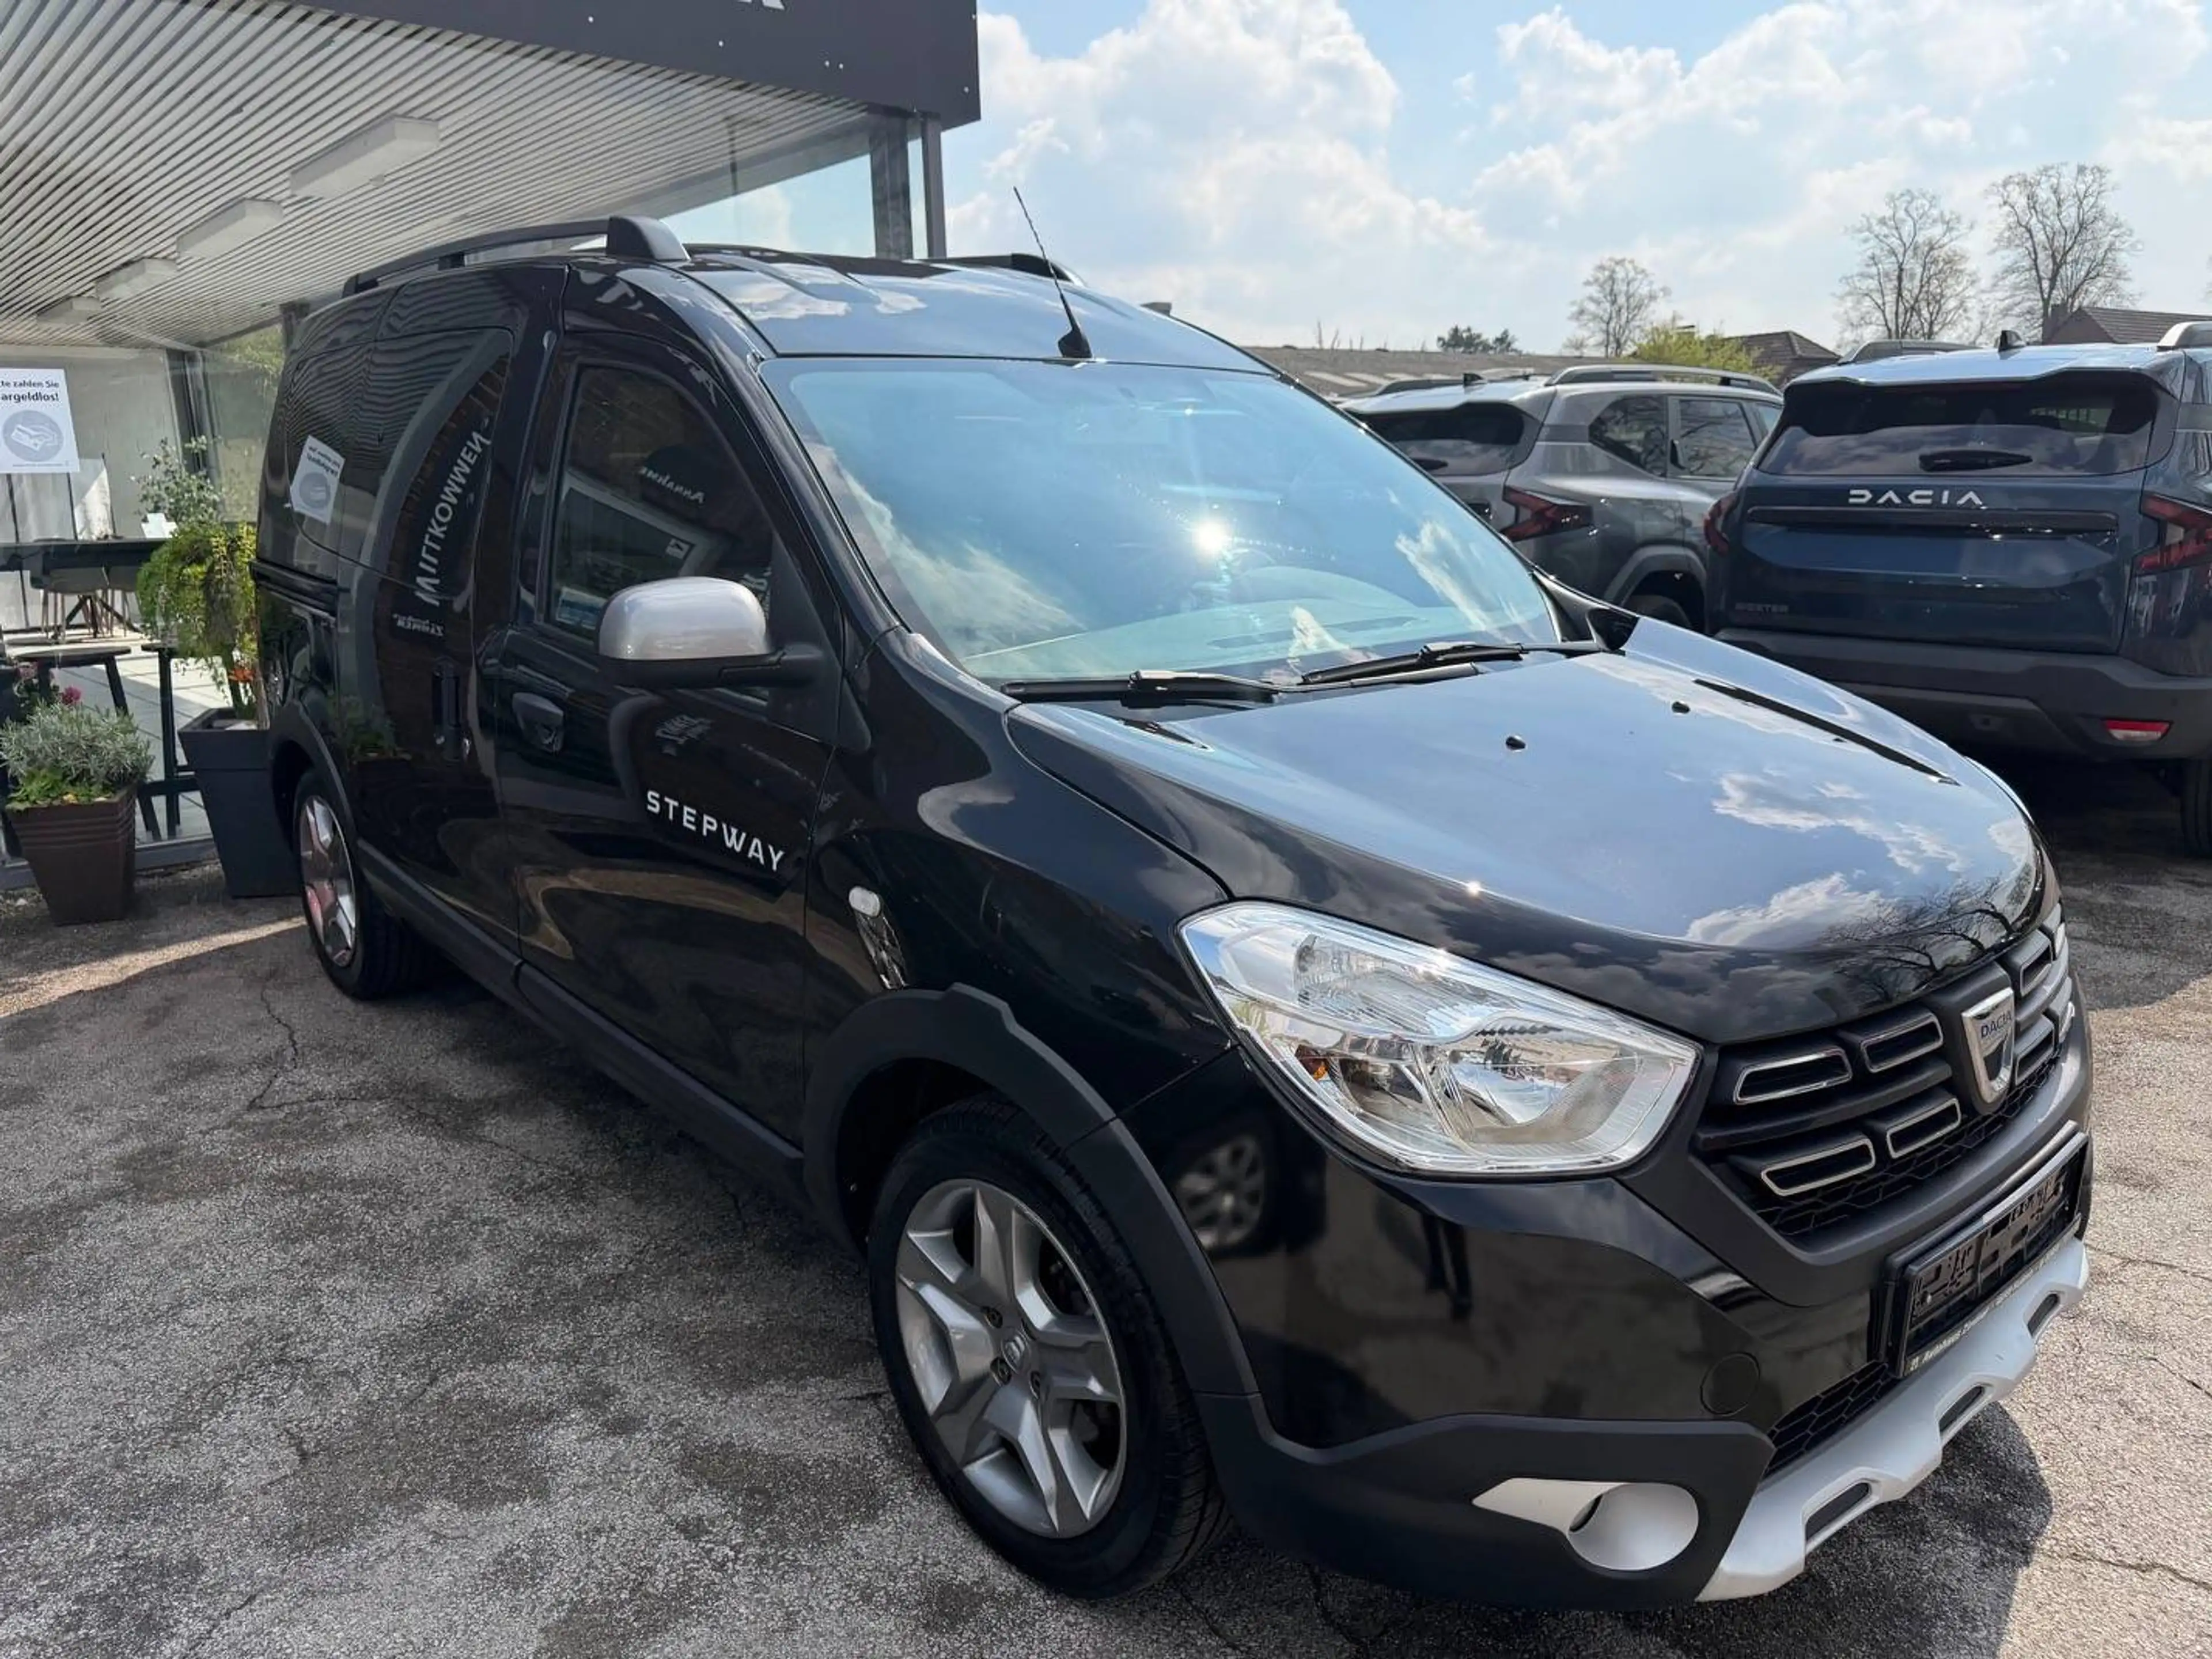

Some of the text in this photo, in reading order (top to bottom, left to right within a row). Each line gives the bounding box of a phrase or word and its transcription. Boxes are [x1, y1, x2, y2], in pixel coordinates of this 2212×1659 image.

[13, 380, 43, 388] zahlen
[1, 392, 59, 403] argeldlos!
[1848, 489, 1983, 505] DACIA
[646, 790, 785, 872] STEPWAY
[1980, 1009, 2012, 1038] DACIA
